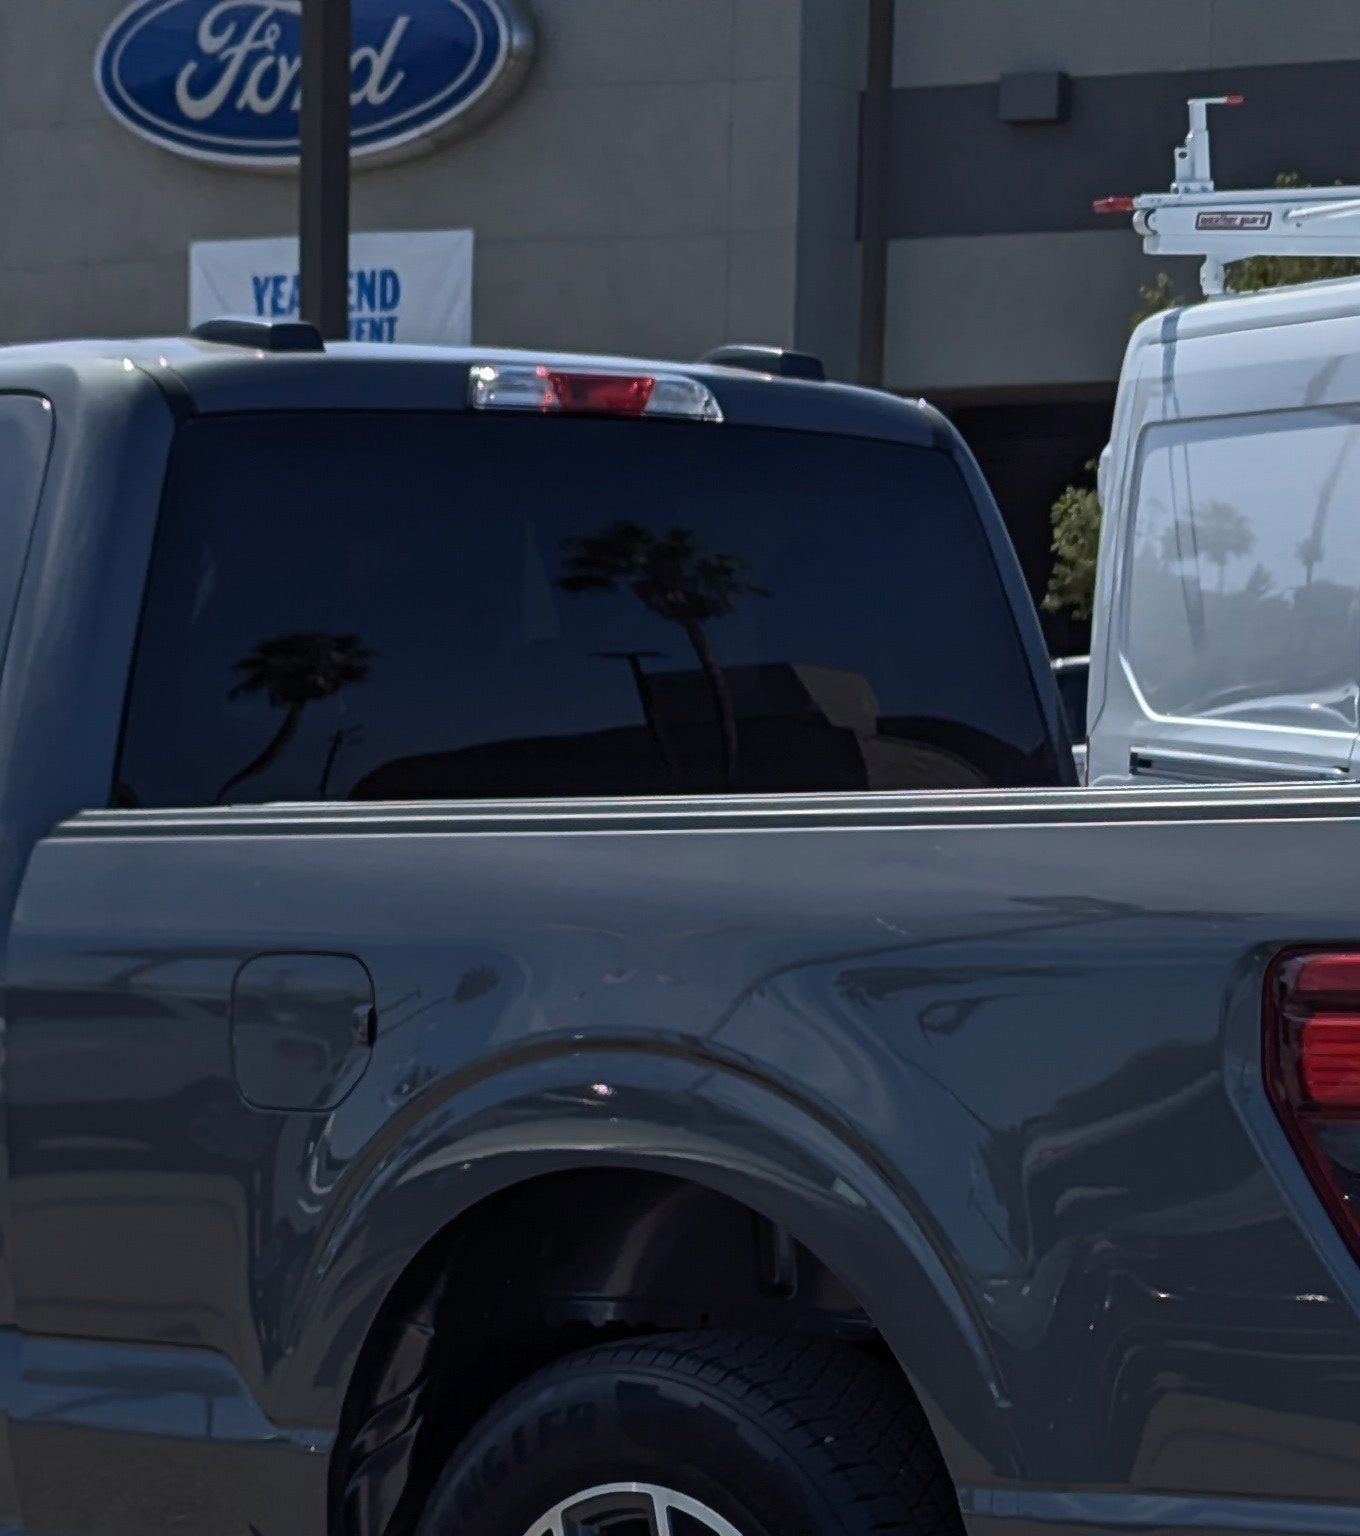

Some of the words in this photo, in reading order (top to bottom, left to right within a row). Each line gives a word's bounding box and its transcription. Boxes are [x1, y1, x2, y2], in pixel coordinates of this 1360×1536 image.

[175, 0, 411, 121] Fod
[252, 275, 300, 316] YEA
[348, 317, 399, 342] ENT
